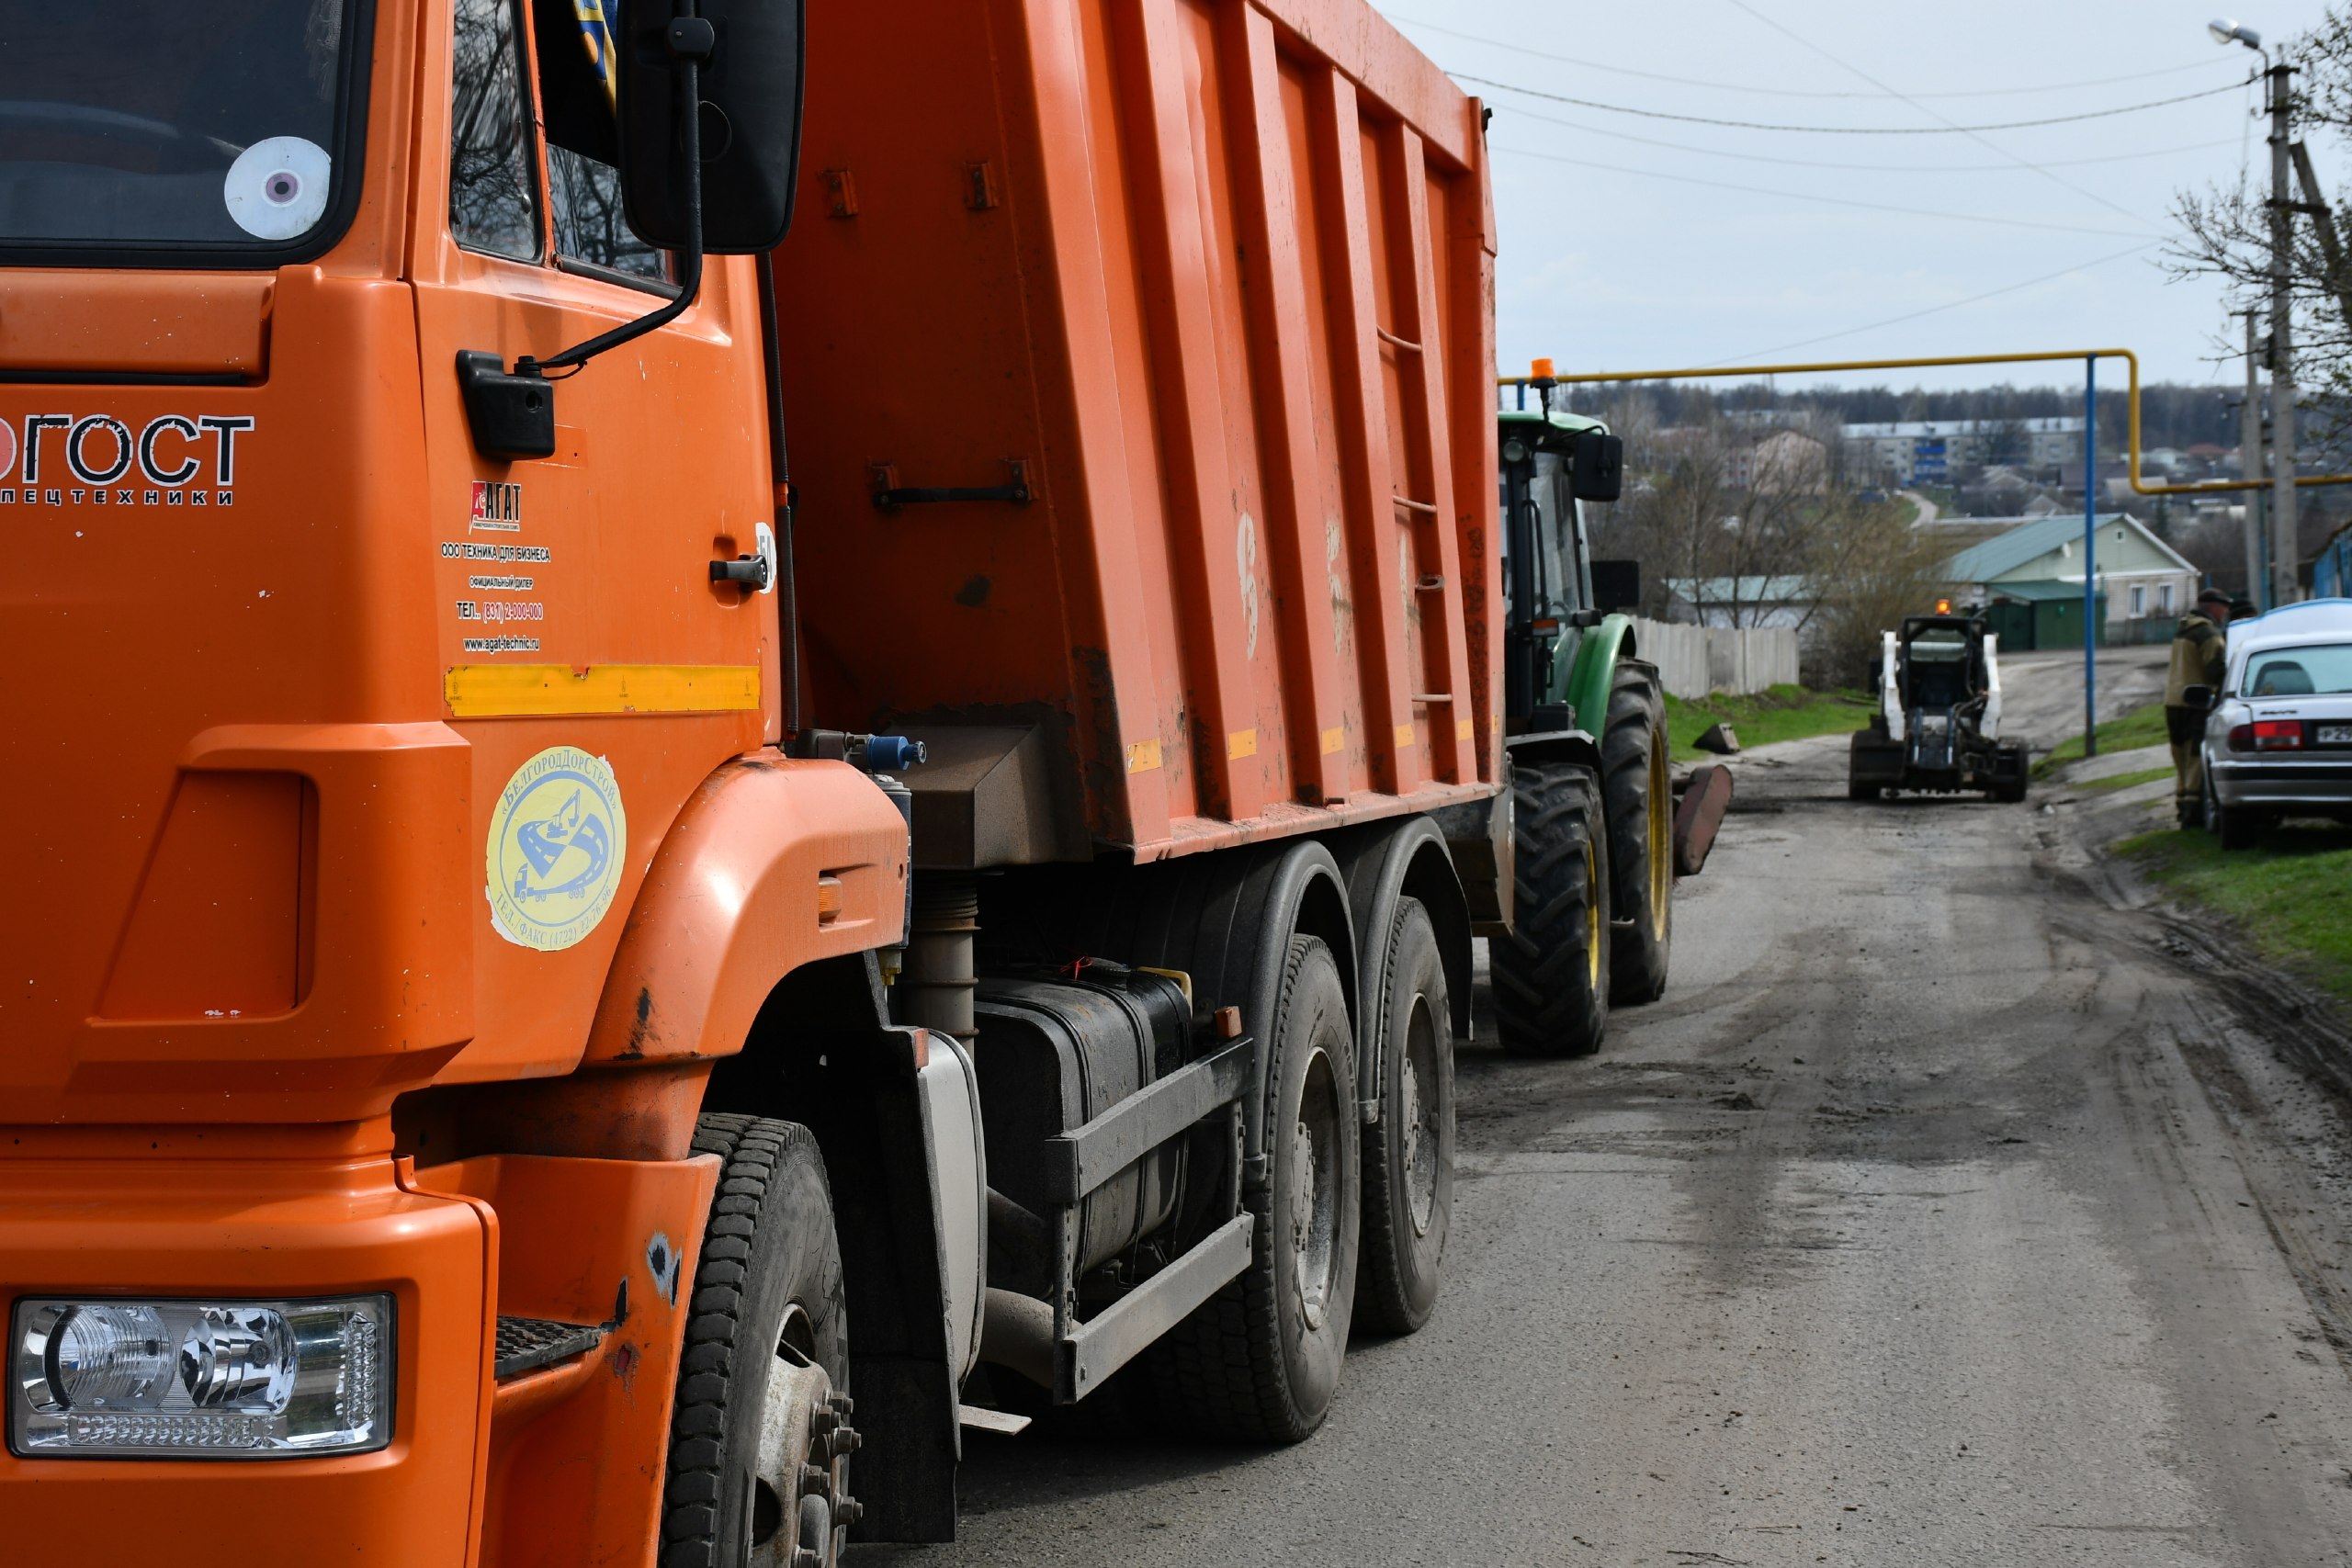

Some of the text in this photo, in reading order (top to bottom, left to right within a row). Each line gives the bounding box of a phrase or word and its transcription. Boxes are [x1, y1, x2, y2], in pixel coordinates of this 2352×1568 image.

[0, 413, 255, 487] ГОСТ
[441, 542, 551, 563] ООО ТЕХНИКА ДЛЯ БИЗНЕСА
[469, 575, 533, 591] ОФИЦИАЛЬНЫЙ ДИЛЕР
[482, 602, 503, 624] (831)
[463, 635, 540, 654] www.agat-technic.ru
